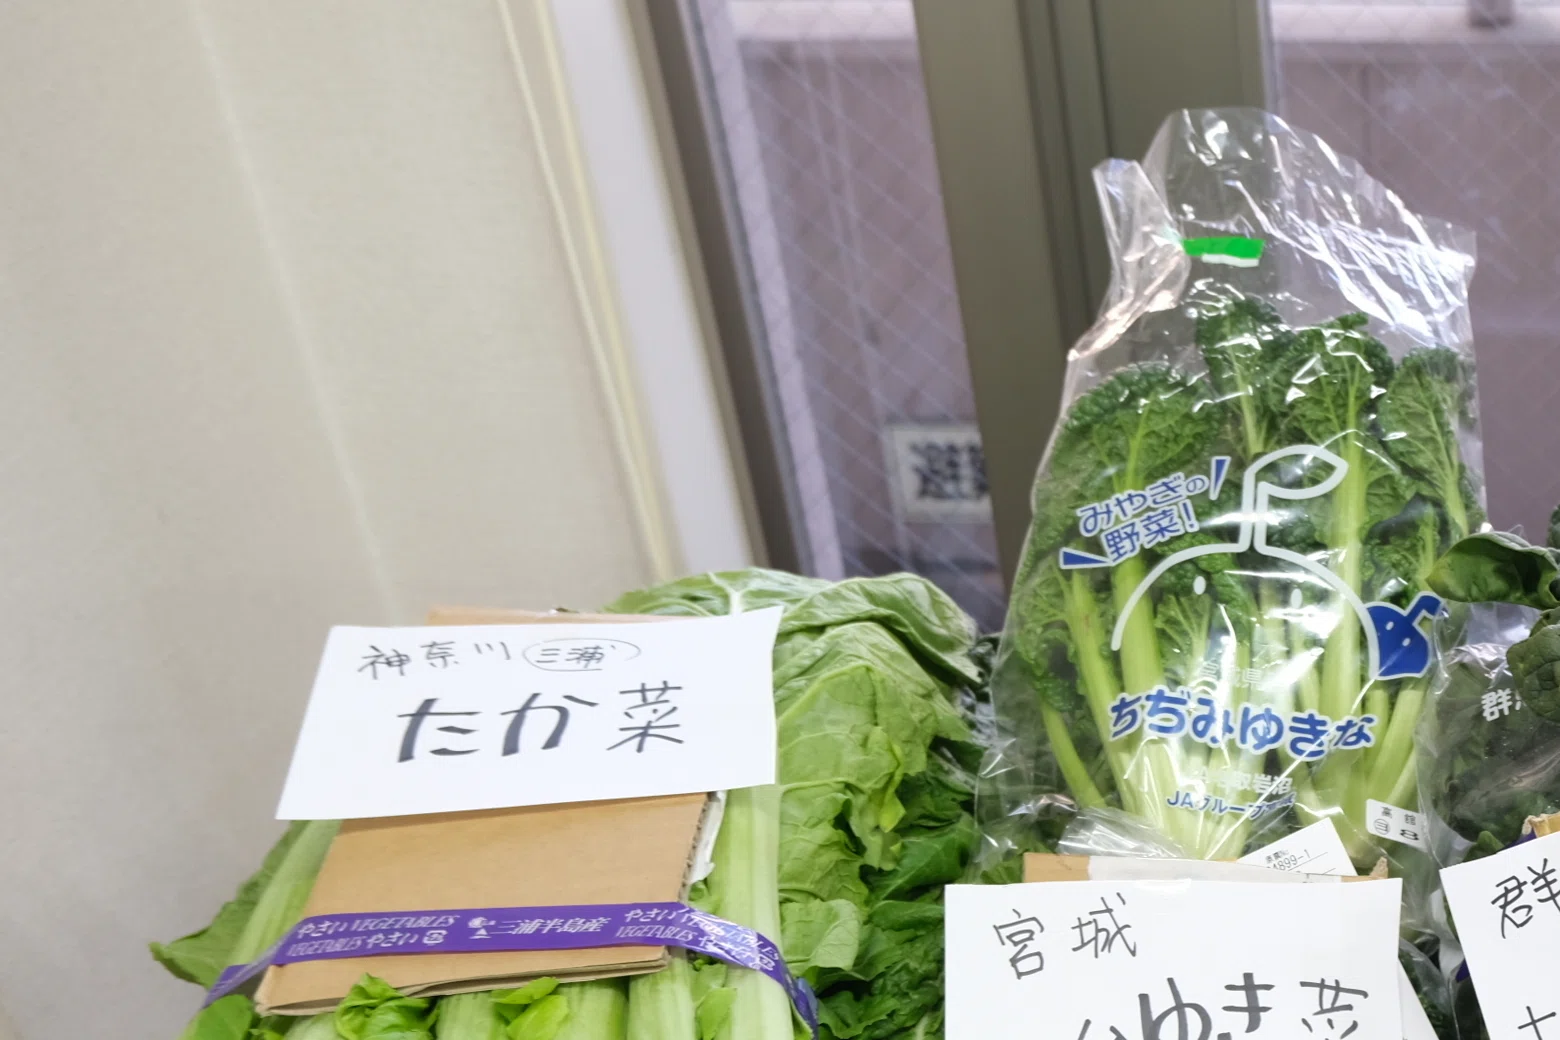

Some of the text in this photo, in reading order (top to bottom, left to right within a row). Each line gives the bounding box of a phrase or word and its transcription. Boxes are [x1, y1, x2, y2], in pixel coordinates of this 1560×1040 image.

[1079, 473, 1208, 536] みやぎの
[358, 641, 511, 679] 神奈川
[398, 680, 685, 762] たか菜
[1111, 687, 1375, 757] ちぢみゆきな
[993, 892, 1137, 979] 宮城
